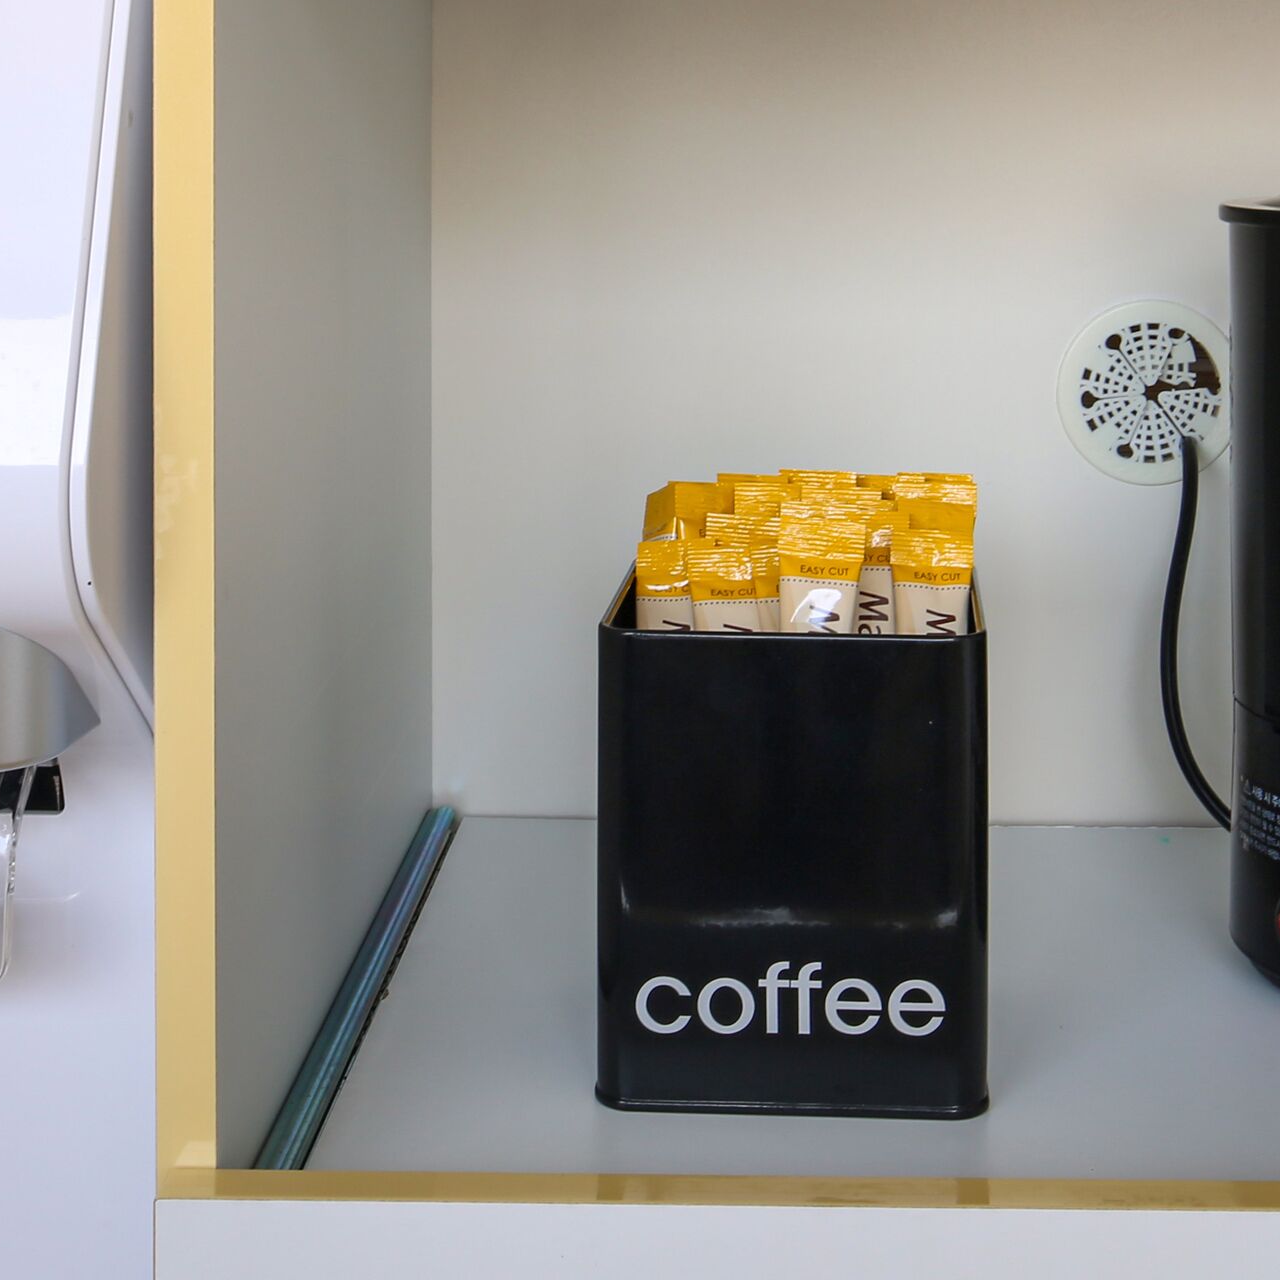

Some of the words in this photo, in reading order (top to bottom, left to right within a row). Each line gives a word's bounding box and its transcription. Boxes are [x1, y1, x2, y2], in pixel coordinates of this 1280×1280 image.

[800, 564, 826, 576] EASY
[827, 566, 850, 577] CUT
[913, 571, 939, 583] EASY
[940, 572, 962, 583] CUT
[710, 588, 736, 598] EASY
[635, 960, 948, 1037] coffee
